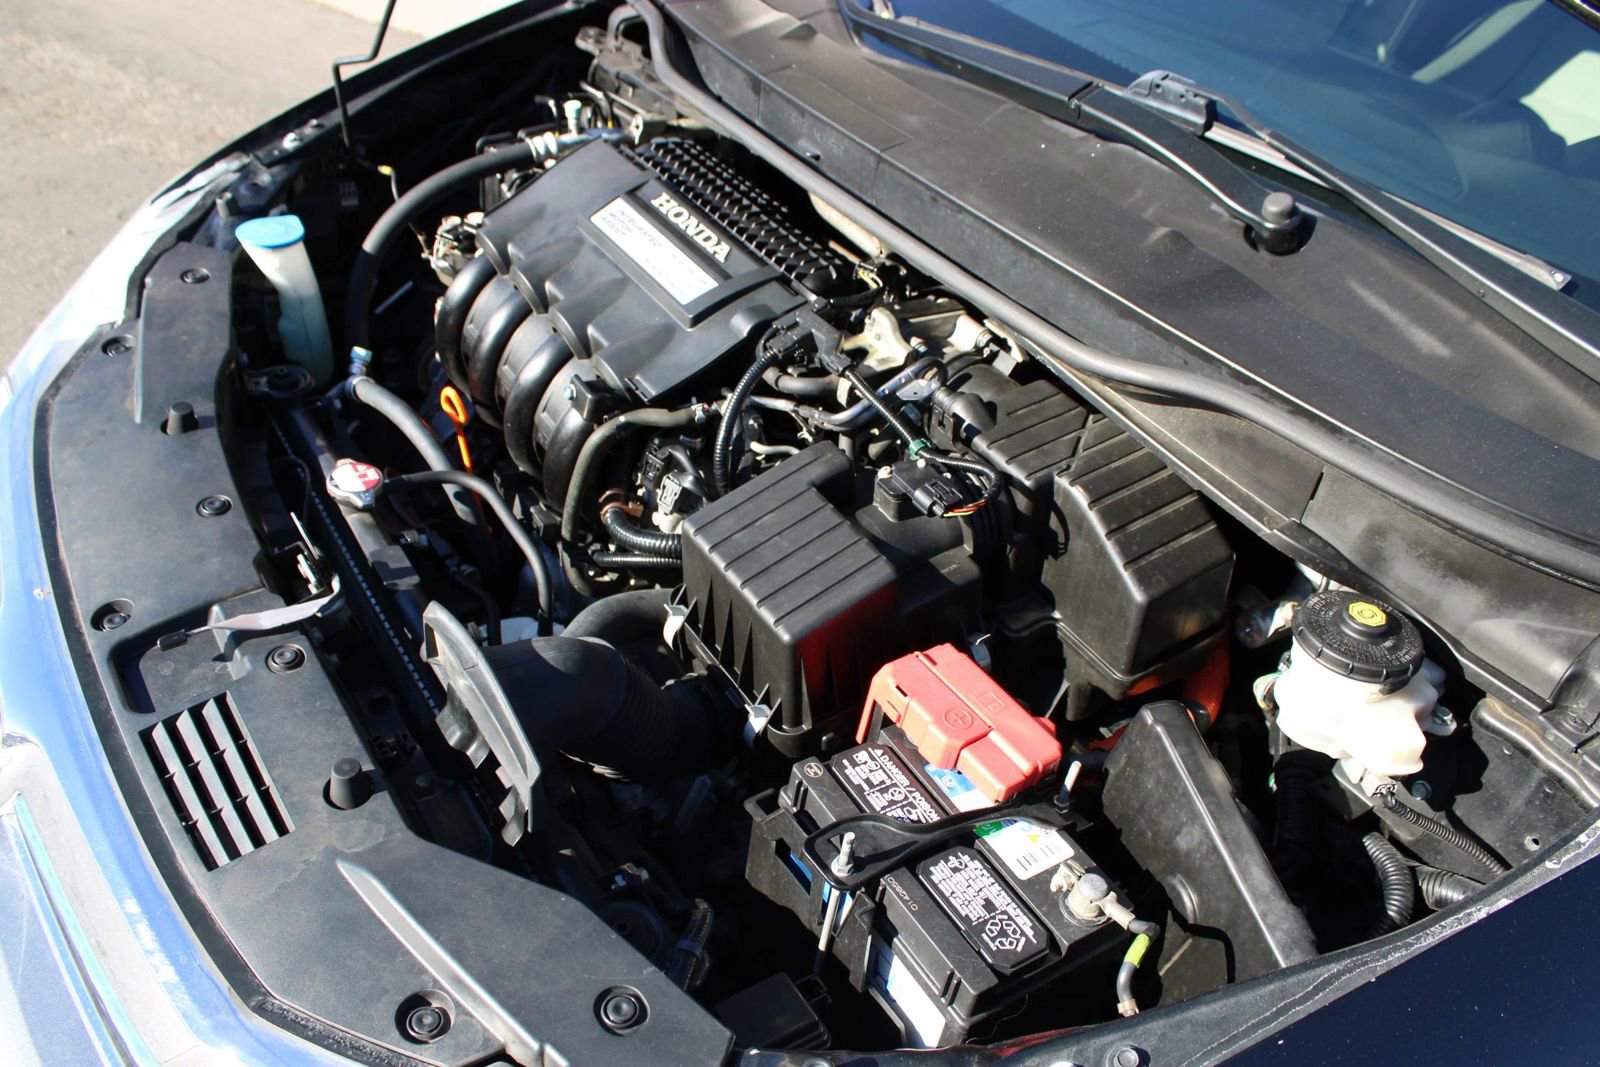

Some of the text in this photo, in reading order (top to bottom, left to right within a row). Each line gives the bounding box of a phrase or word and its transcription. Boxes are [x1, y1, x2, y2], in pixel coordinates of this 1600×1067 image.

[651, 192, 732, 264] HONDA
[879, 756, 911, 786] DANGER
[910, 792, 941, 822] POISON
